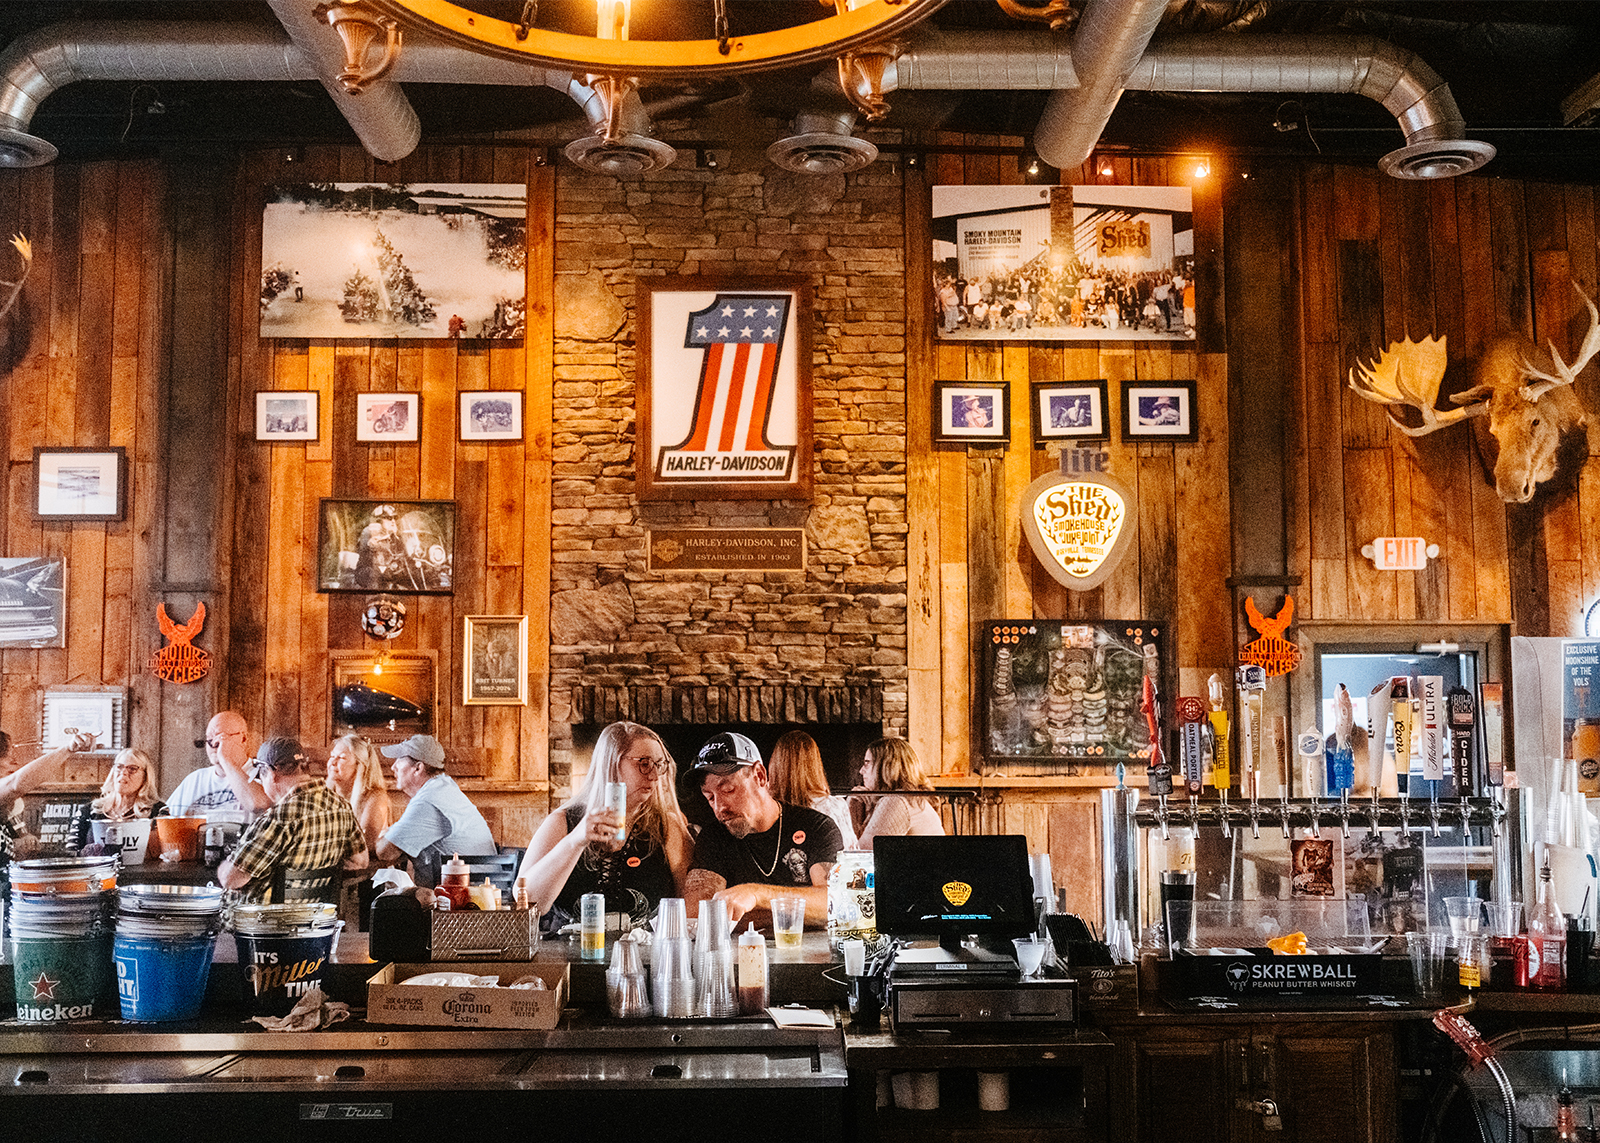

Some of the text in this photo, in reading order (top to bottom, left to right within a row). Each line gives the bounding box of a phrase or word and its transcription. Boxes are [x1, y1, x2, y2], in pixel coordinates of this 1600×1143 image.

[964, 229, 1022, 238] SMOKY MOUNTAIN
[964, 237, 1021, 245] HARLEY-DAVIDSON
[665, 455, 786, 472] HARLEY-DAVIDSON
[1066, 485, 1104, 500] THE
[1045, 489, 1112, 522] Shed
[685, 538, 800, 548] HARLEY-DAVIDSON, INC.
[1383, 539, 1420, 568] EXIT
[159, 644, 201, 660] MOTOR
[1250, 637, 1292, 654] MOTOR
[1566, 645, 1598, 655] EXCLUSIVE
[1565, 656, 1600, 665] MOONSHINE
[158, 666, 202, 684] CYCLES
[1571, 666, 1592, 676] OF THE
[1425, 681, 1436, 722] ULTRA
[1394, 720, 1406, 754] Coors
[1188, 723, 1198, 780] OATMEAL PORTER
[1460, 740, 1469, 786] CIDER
[43, 803, 71, 818] JACKIE
[254, 951, 279, 964] IT'S
[244, 955, 327, 997] Miller
[1091, 969, 1116, 979] Tito's
[1252, 964, 1357, 979] SKREWBALL
[1252, 980, 1357, 988] PEANUT BUTTER WHISKEY
[441, 998, 493, 1016] Corona
[454, 1012, 479, 1023] Extra
[339, 1105, 384, 1117] true
